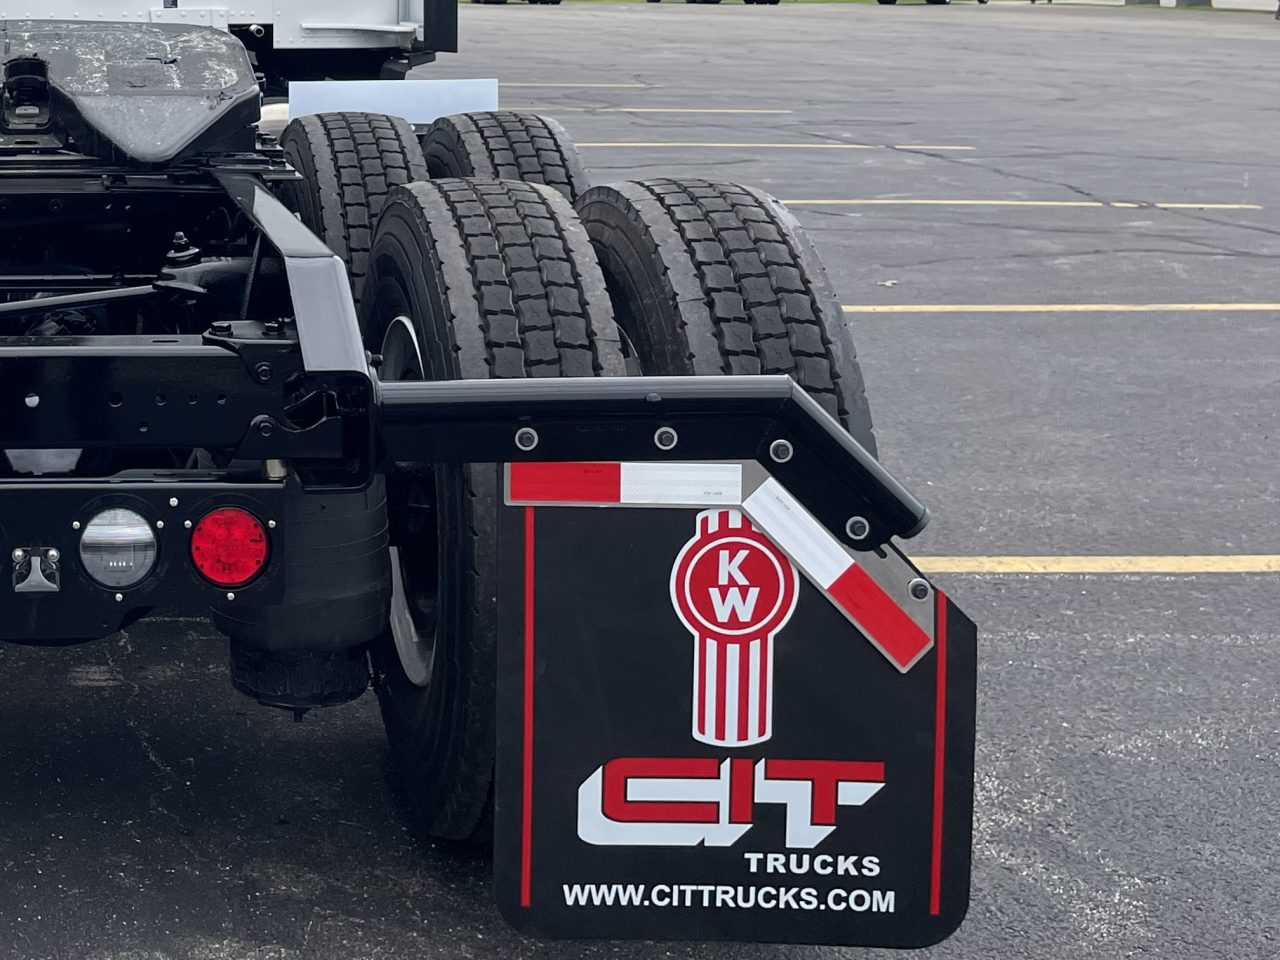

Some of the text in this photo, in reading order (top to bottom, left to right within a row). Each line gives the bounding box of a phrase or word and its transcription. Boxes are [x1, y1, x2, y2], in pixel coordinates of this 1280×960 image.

[577, 757, 886, 848] CIT
[744, 852, 881, 877] TRUCKS
[562, 884, 895, 913] WWW.CITTRUCKS.COM
